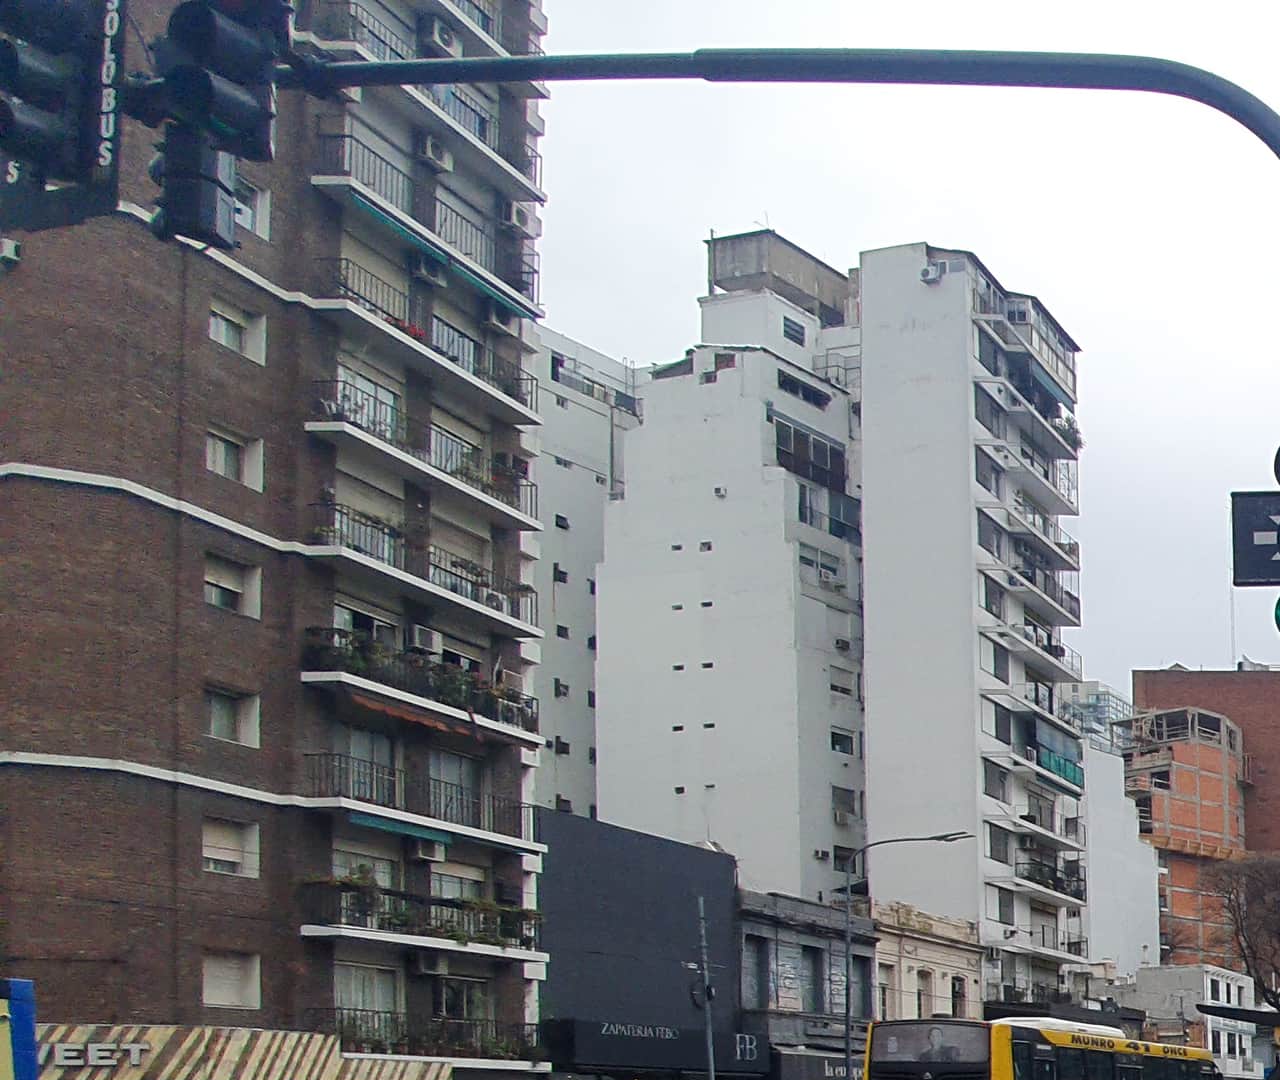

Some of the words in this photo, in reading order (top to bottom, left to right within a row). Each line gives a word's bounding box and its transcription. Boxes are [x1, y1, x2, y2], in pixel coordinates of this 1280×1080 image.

[38, 1043, 151, 1065] EET
[735, 1033, 758, 1060] FB
[1071, 1034, 1115, 1049] MUNRO
[1126, 1041, 1150, 1052] 41
[1162, 1046, 1188, 1056] ONCE
